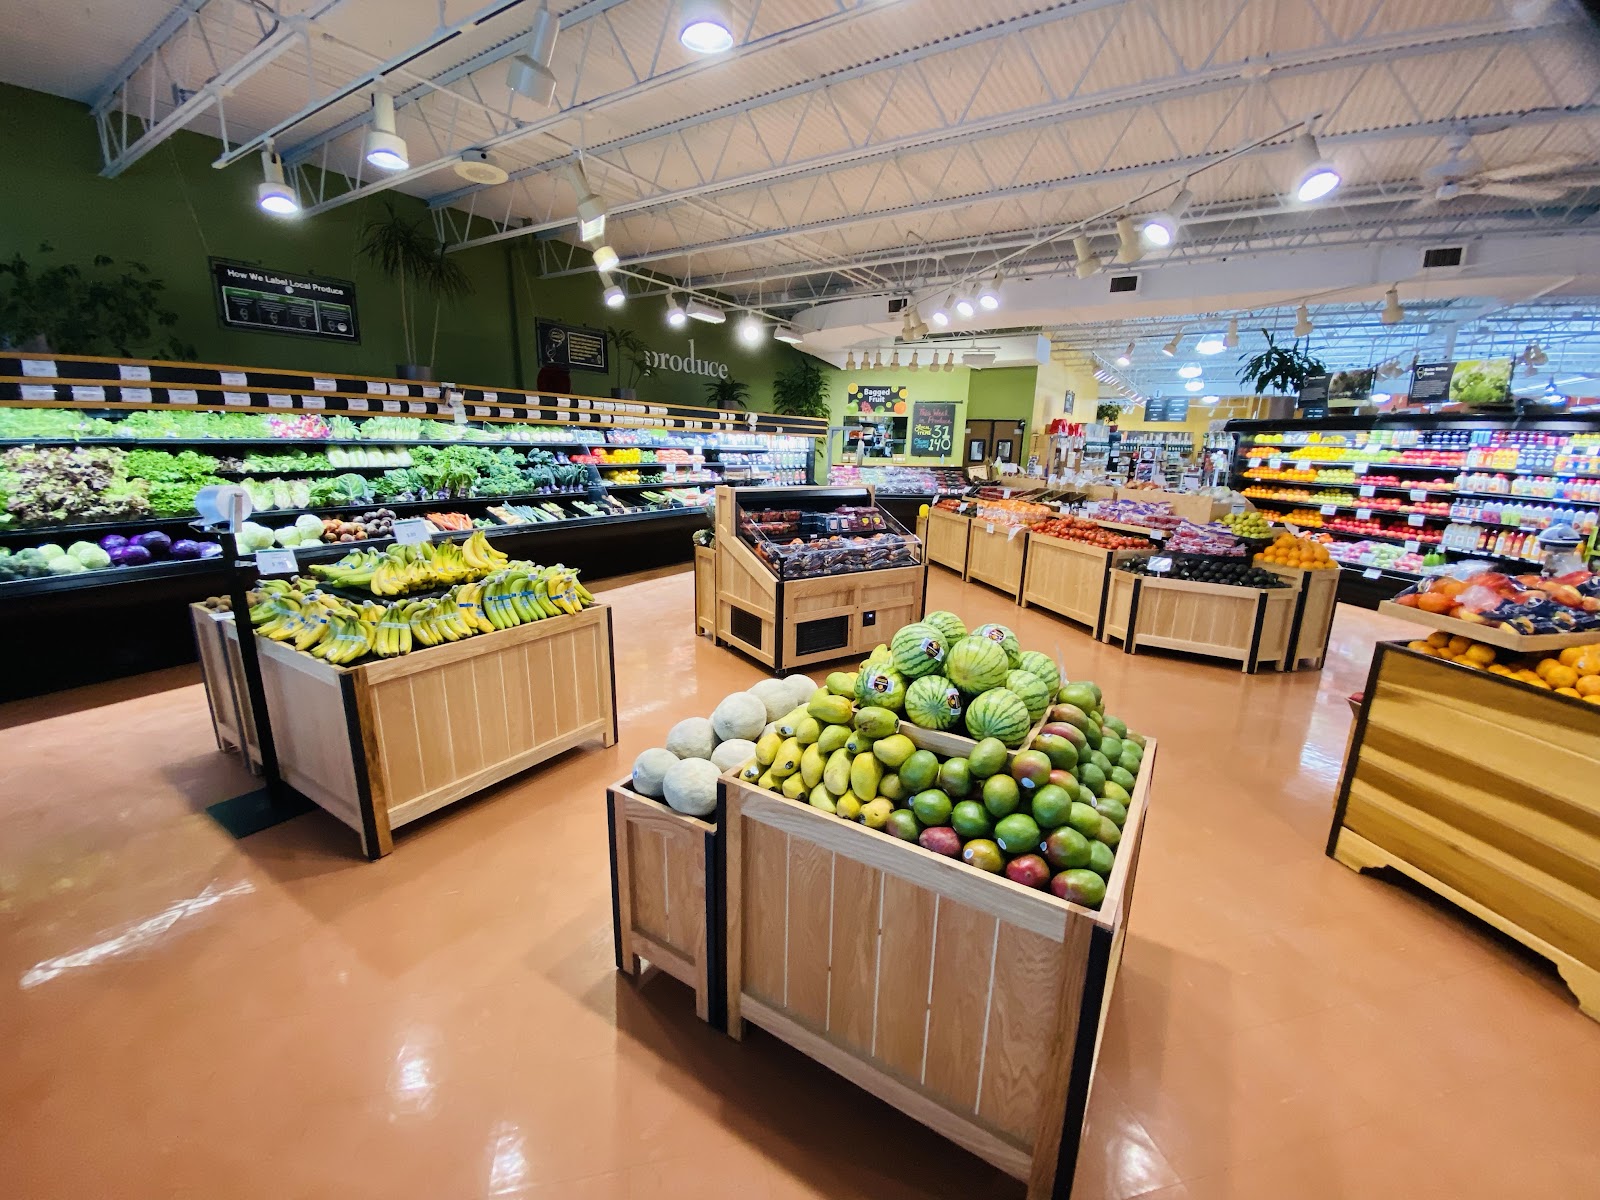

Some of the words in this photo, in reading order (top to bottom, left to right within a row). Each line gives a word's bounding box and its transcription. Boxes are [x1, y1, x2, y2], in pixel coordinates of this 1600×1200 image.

[227, 269, 248, 279] How
[249, 272, 264, 281] We
[265, 275, 288, 286] Label
[289, 279, 311, 289] Local
[312, 283, 344, 296] Produce
[864, 388, 890, 396] Bagged
[931, 425, 950, 438] 31
[928, 438, 950, 451] 140
